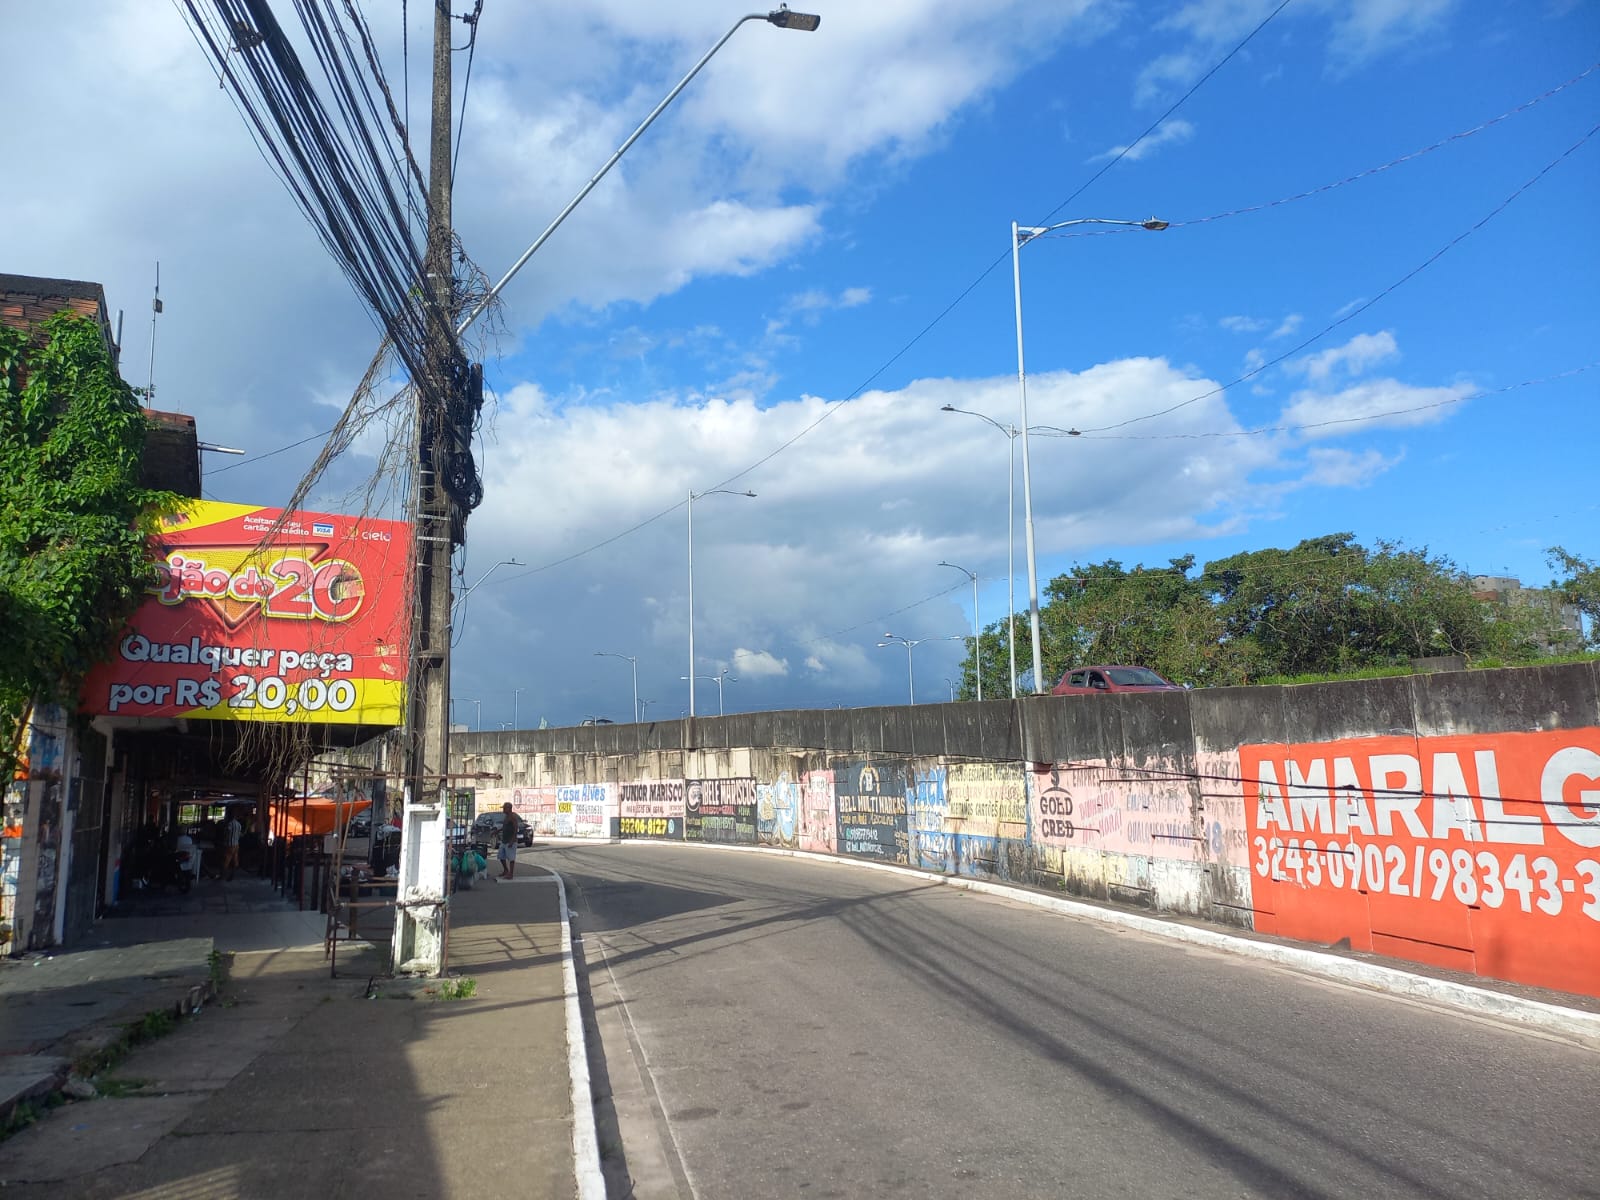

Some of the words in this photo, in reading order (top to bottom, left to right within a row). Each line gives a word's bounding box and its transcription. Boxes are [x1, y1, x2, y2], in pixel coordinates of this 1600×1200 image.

[243, 524, 270, 532] cartão
[361, 531, 391, 542] cielo
[154, 557, 229, 600] ojão
[233, 568, 275, 597] do
[268, 559, 363, 617] 20
[120, 634, 275, 672] Qualquer
[278, 649, 353, 678] peça
[108, 683, 171, 712] por
[176, 677, 221, 709] R$
[228, 675, 356, 715] 20,00
[557, 787, 580, 802] Casa
[581, 784, 606, 802] Alves
[620, 784, 648, 802] JUNIOR
[649, 783, 683, 802] MARISCO
[840, 796, 857, 813] BELL
[857, 795, 878, 813] MULTI
[879, 796, 906, 815] MARCAS
[1040, 796, 1073, 815] GOLD
[1042, 819, 1074, 838] CRED
